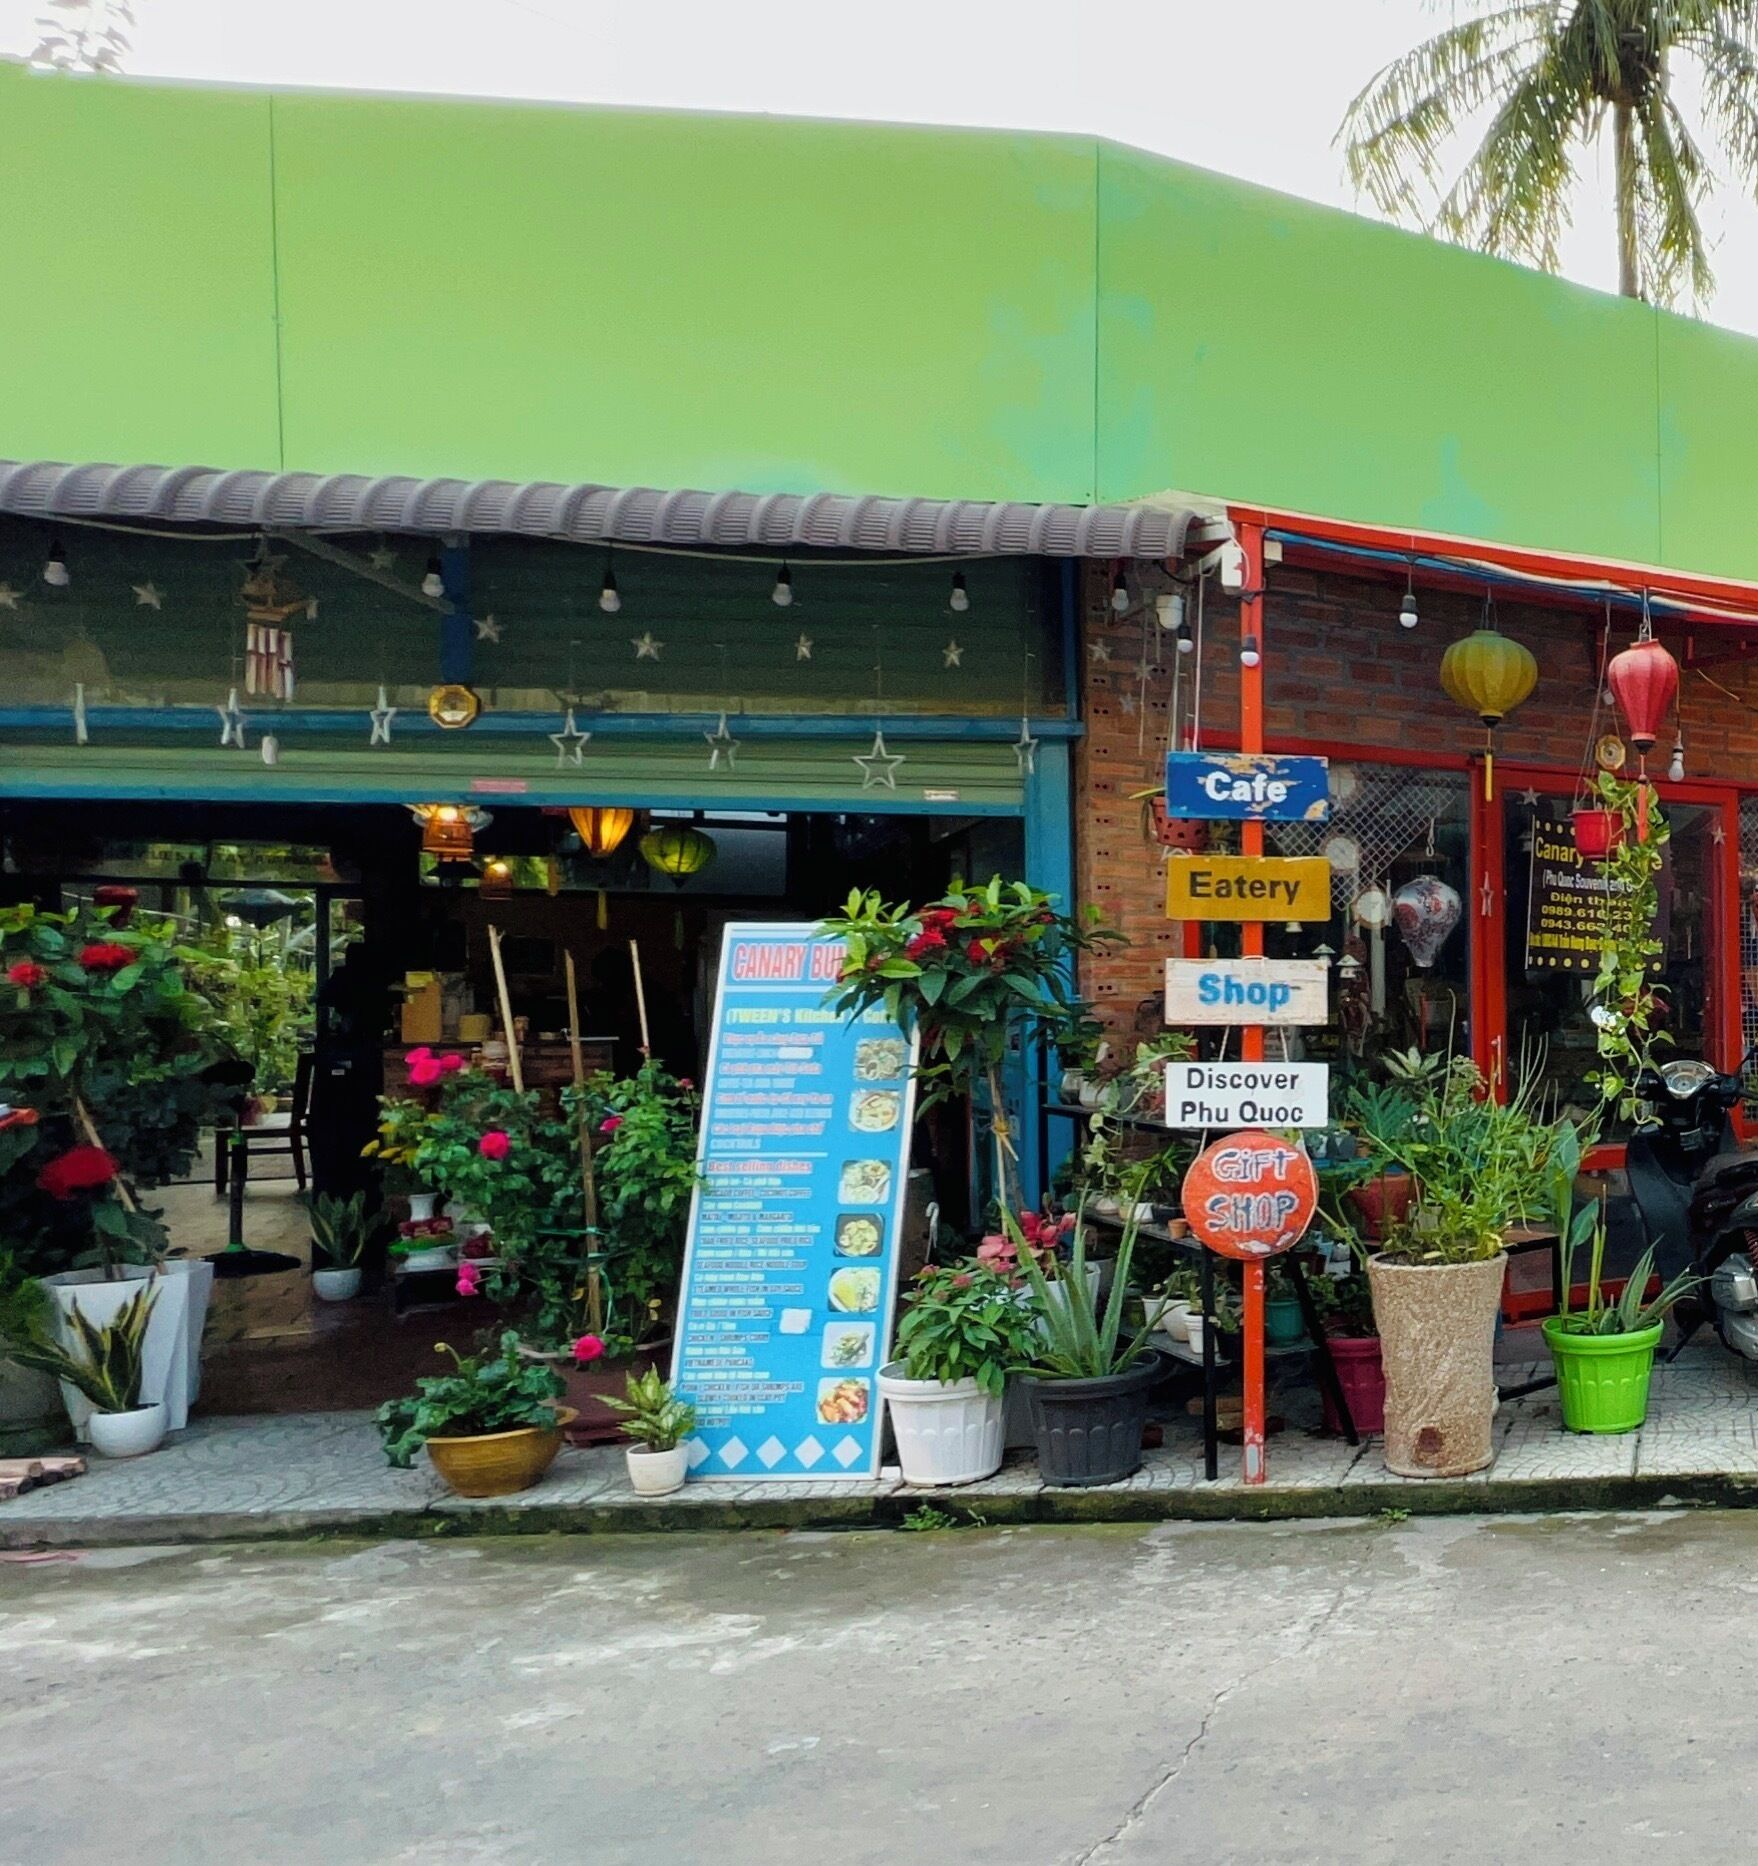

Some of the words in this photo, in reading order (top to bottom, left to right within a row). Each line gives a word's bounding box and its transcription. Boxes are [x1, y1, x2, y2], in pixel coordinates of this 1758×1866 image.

[1205, 771, 1288, 802] Cafe
[1535, 837, 1584, 868] Canary
[1189, 871, 1301, 905] Eatery
[733, 943, 807, 980] CANARY
[1198, 973, 1291, 1012] Shop
[1187, 1067, 1300, 1090] Discover
[1180, 1101, 1229, 1122] Phu
[1239, 1101, 1304, 1123] Quoc
[1205, 1191, 1299, 1233] SHOP
